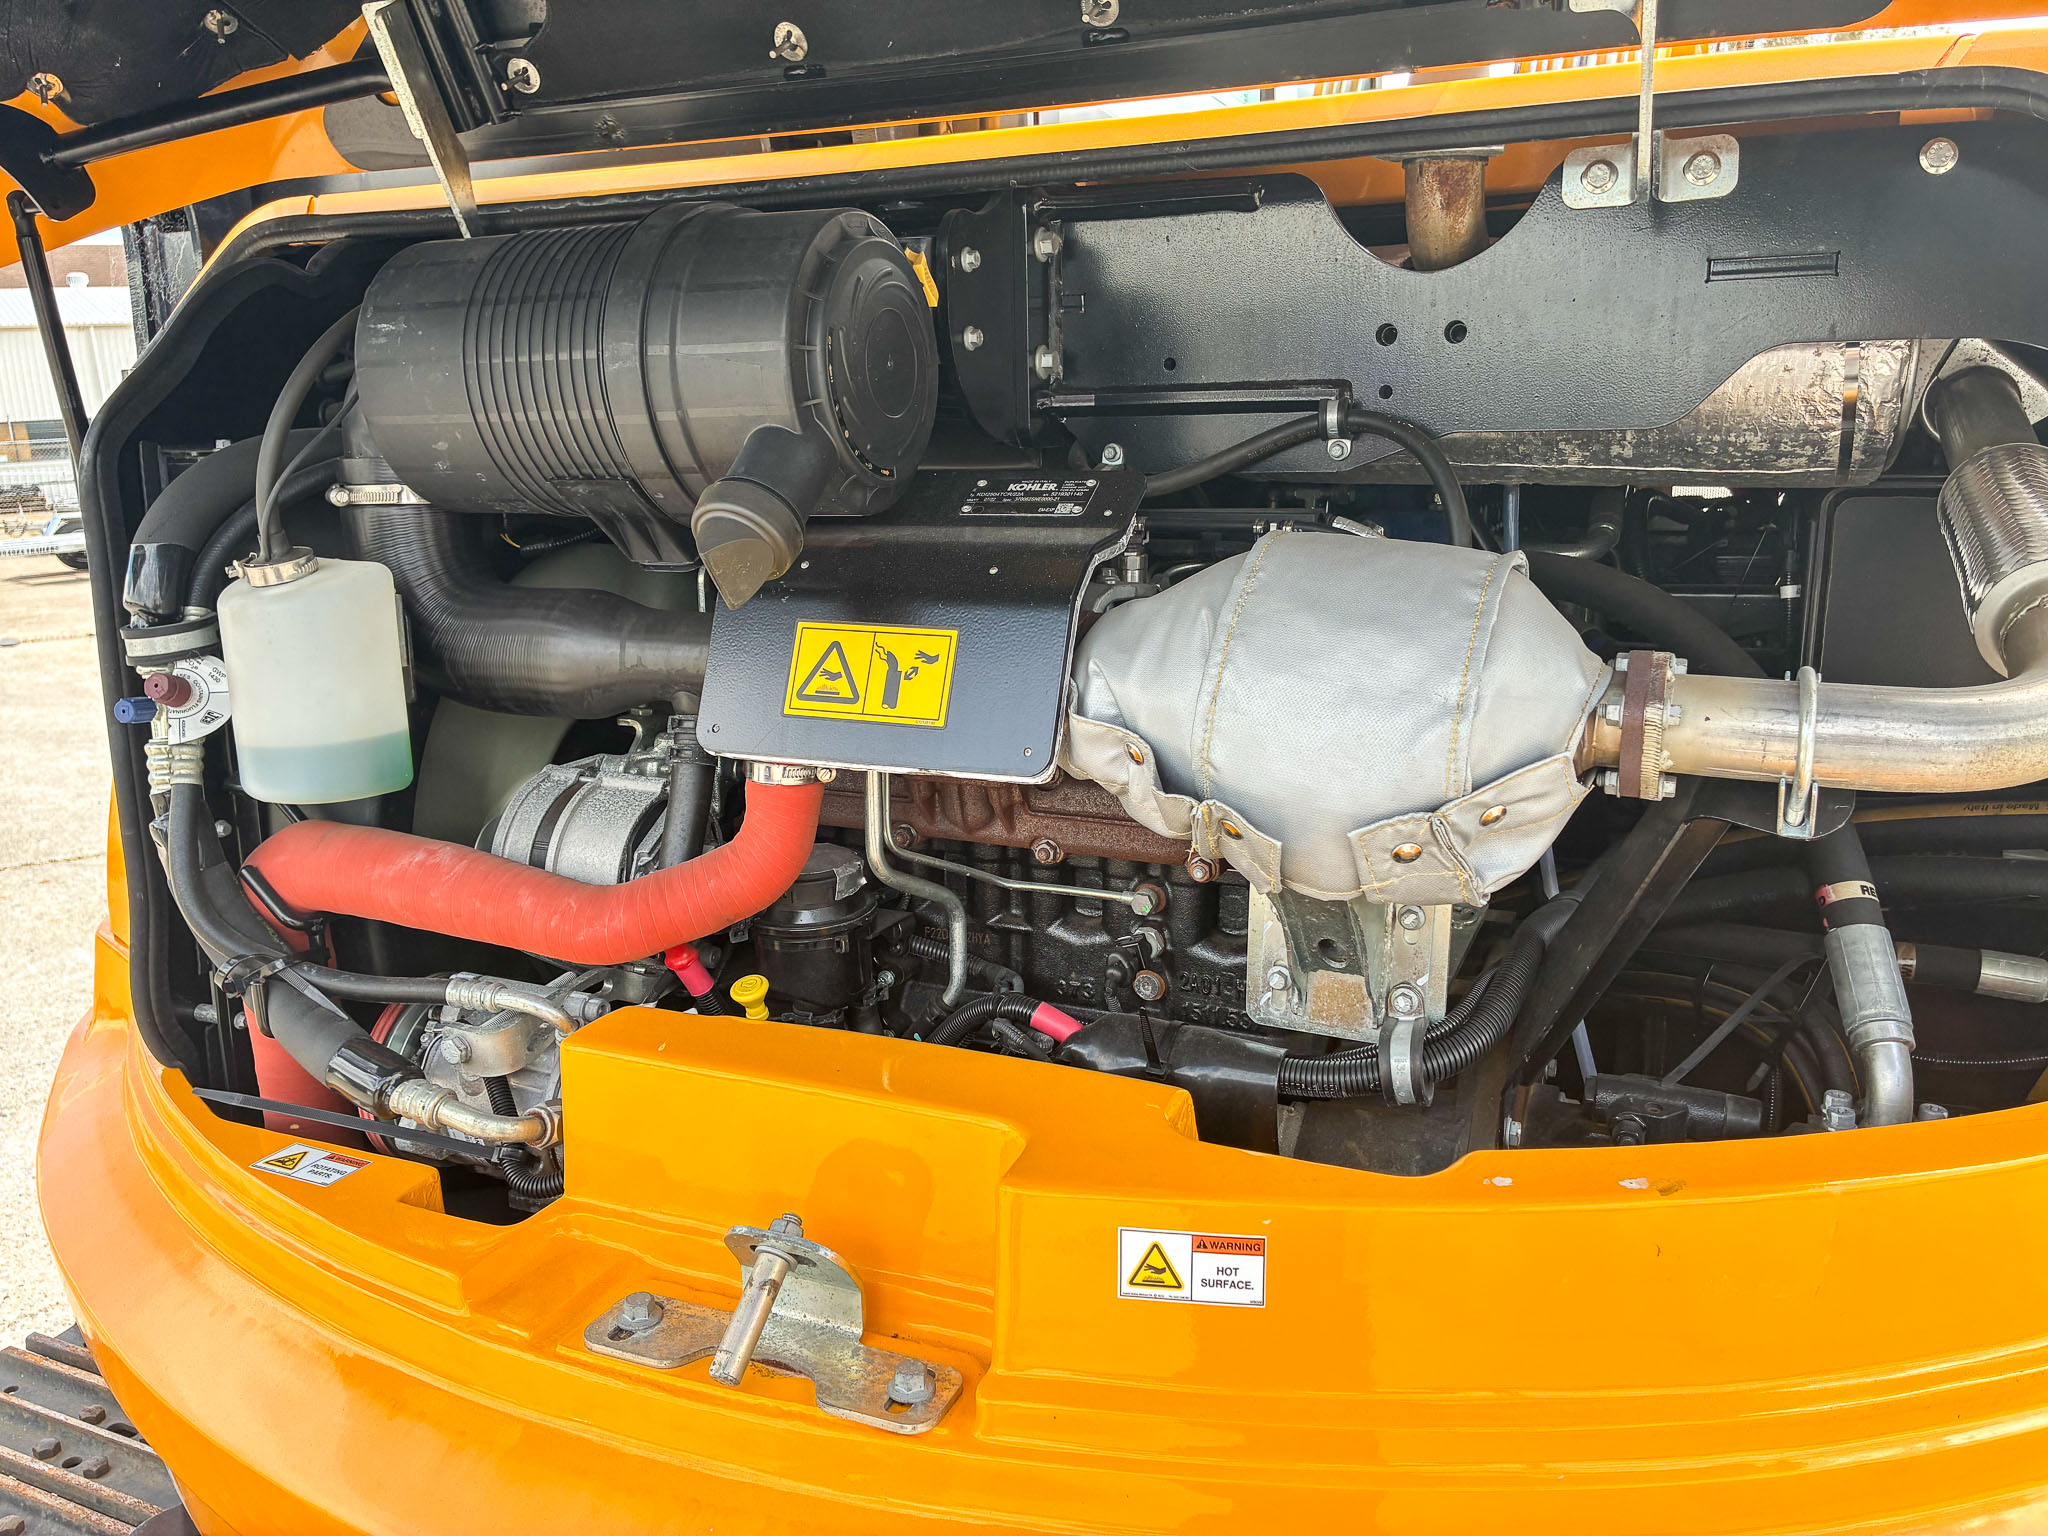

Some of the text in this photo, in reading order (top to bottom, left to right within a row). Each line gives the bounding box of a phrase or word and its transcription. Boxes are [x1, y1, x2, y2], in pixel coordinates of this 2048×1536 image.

[310, 1163, 348, 1176] ROTATING
[1209, 1240, 1261, 1252] WARNING
[1216, 1266, 1240, 1277] HOT
[1200, 1278, 1255, 1291] SURFACE.
